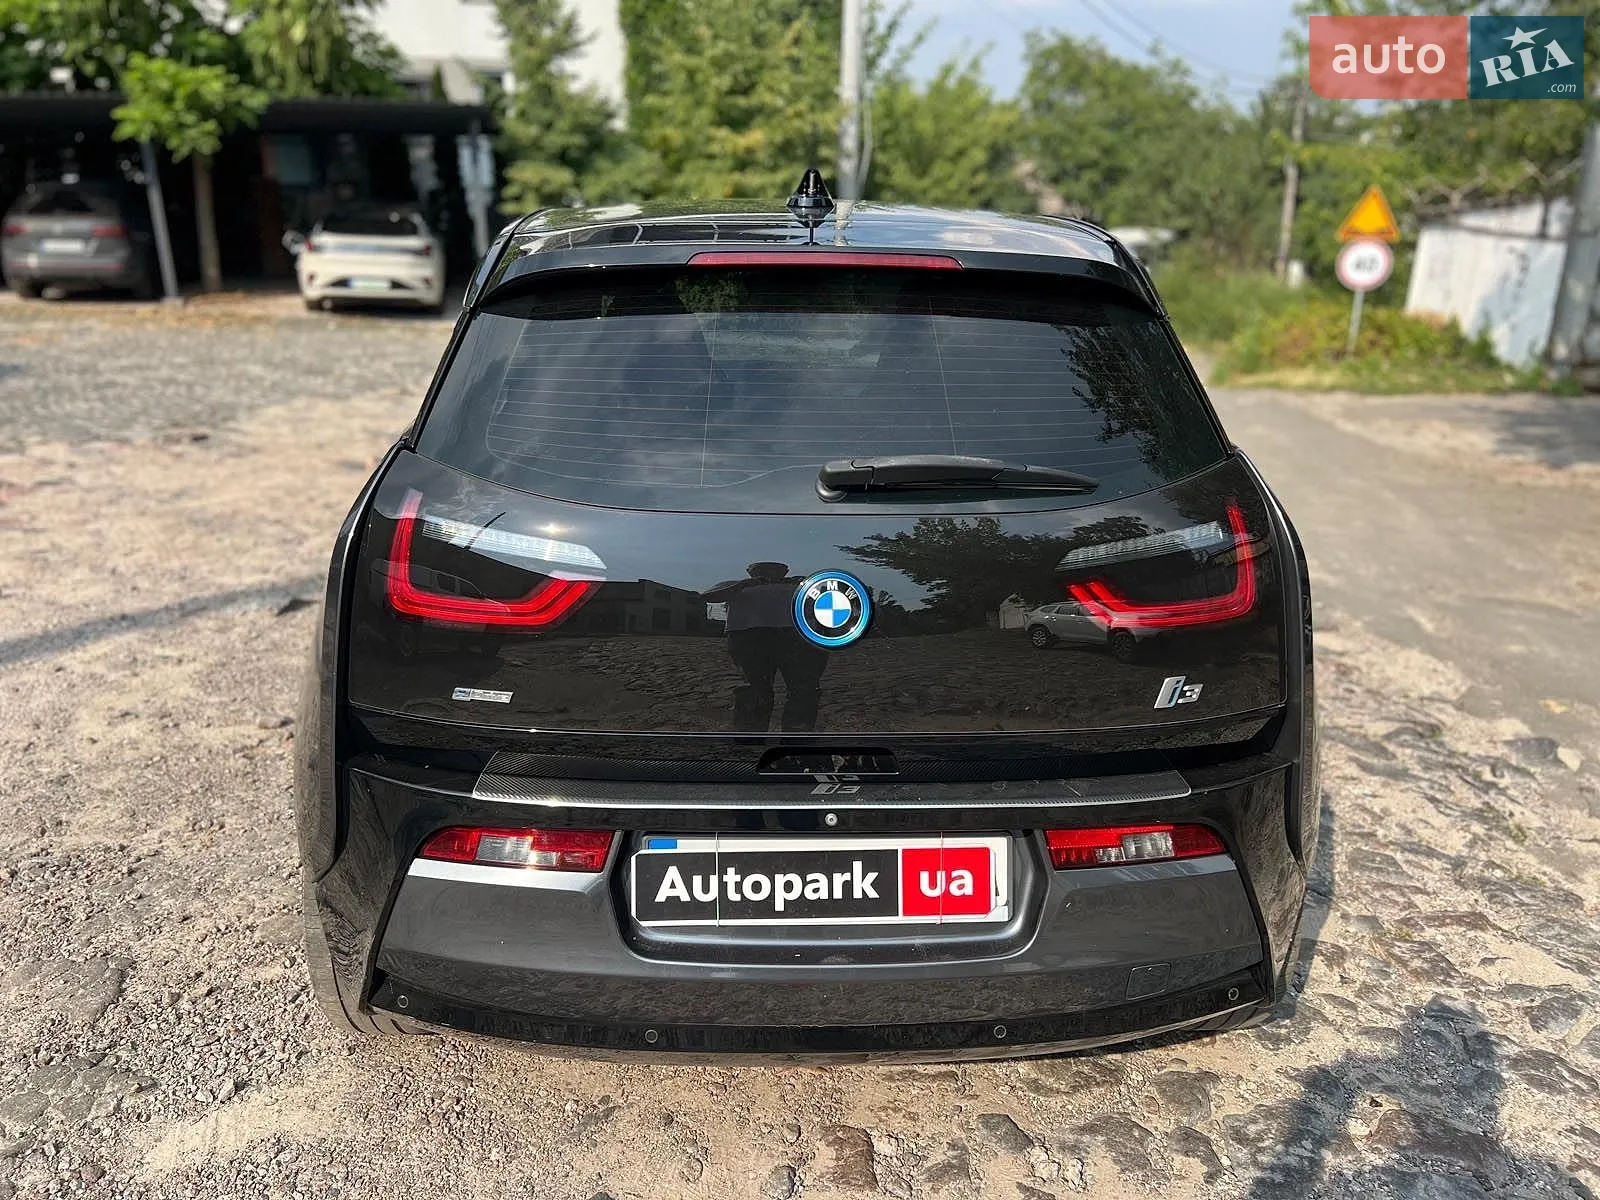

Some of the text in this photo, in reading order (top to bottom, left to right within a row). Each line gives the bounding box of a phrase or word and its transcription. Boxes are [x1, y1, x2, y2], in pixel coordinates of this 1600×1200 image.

[808, 580, 858, 600] BMW
[1153, 676, 1204, 709] i3
[654, 860, 974, 912] Autopark ua
